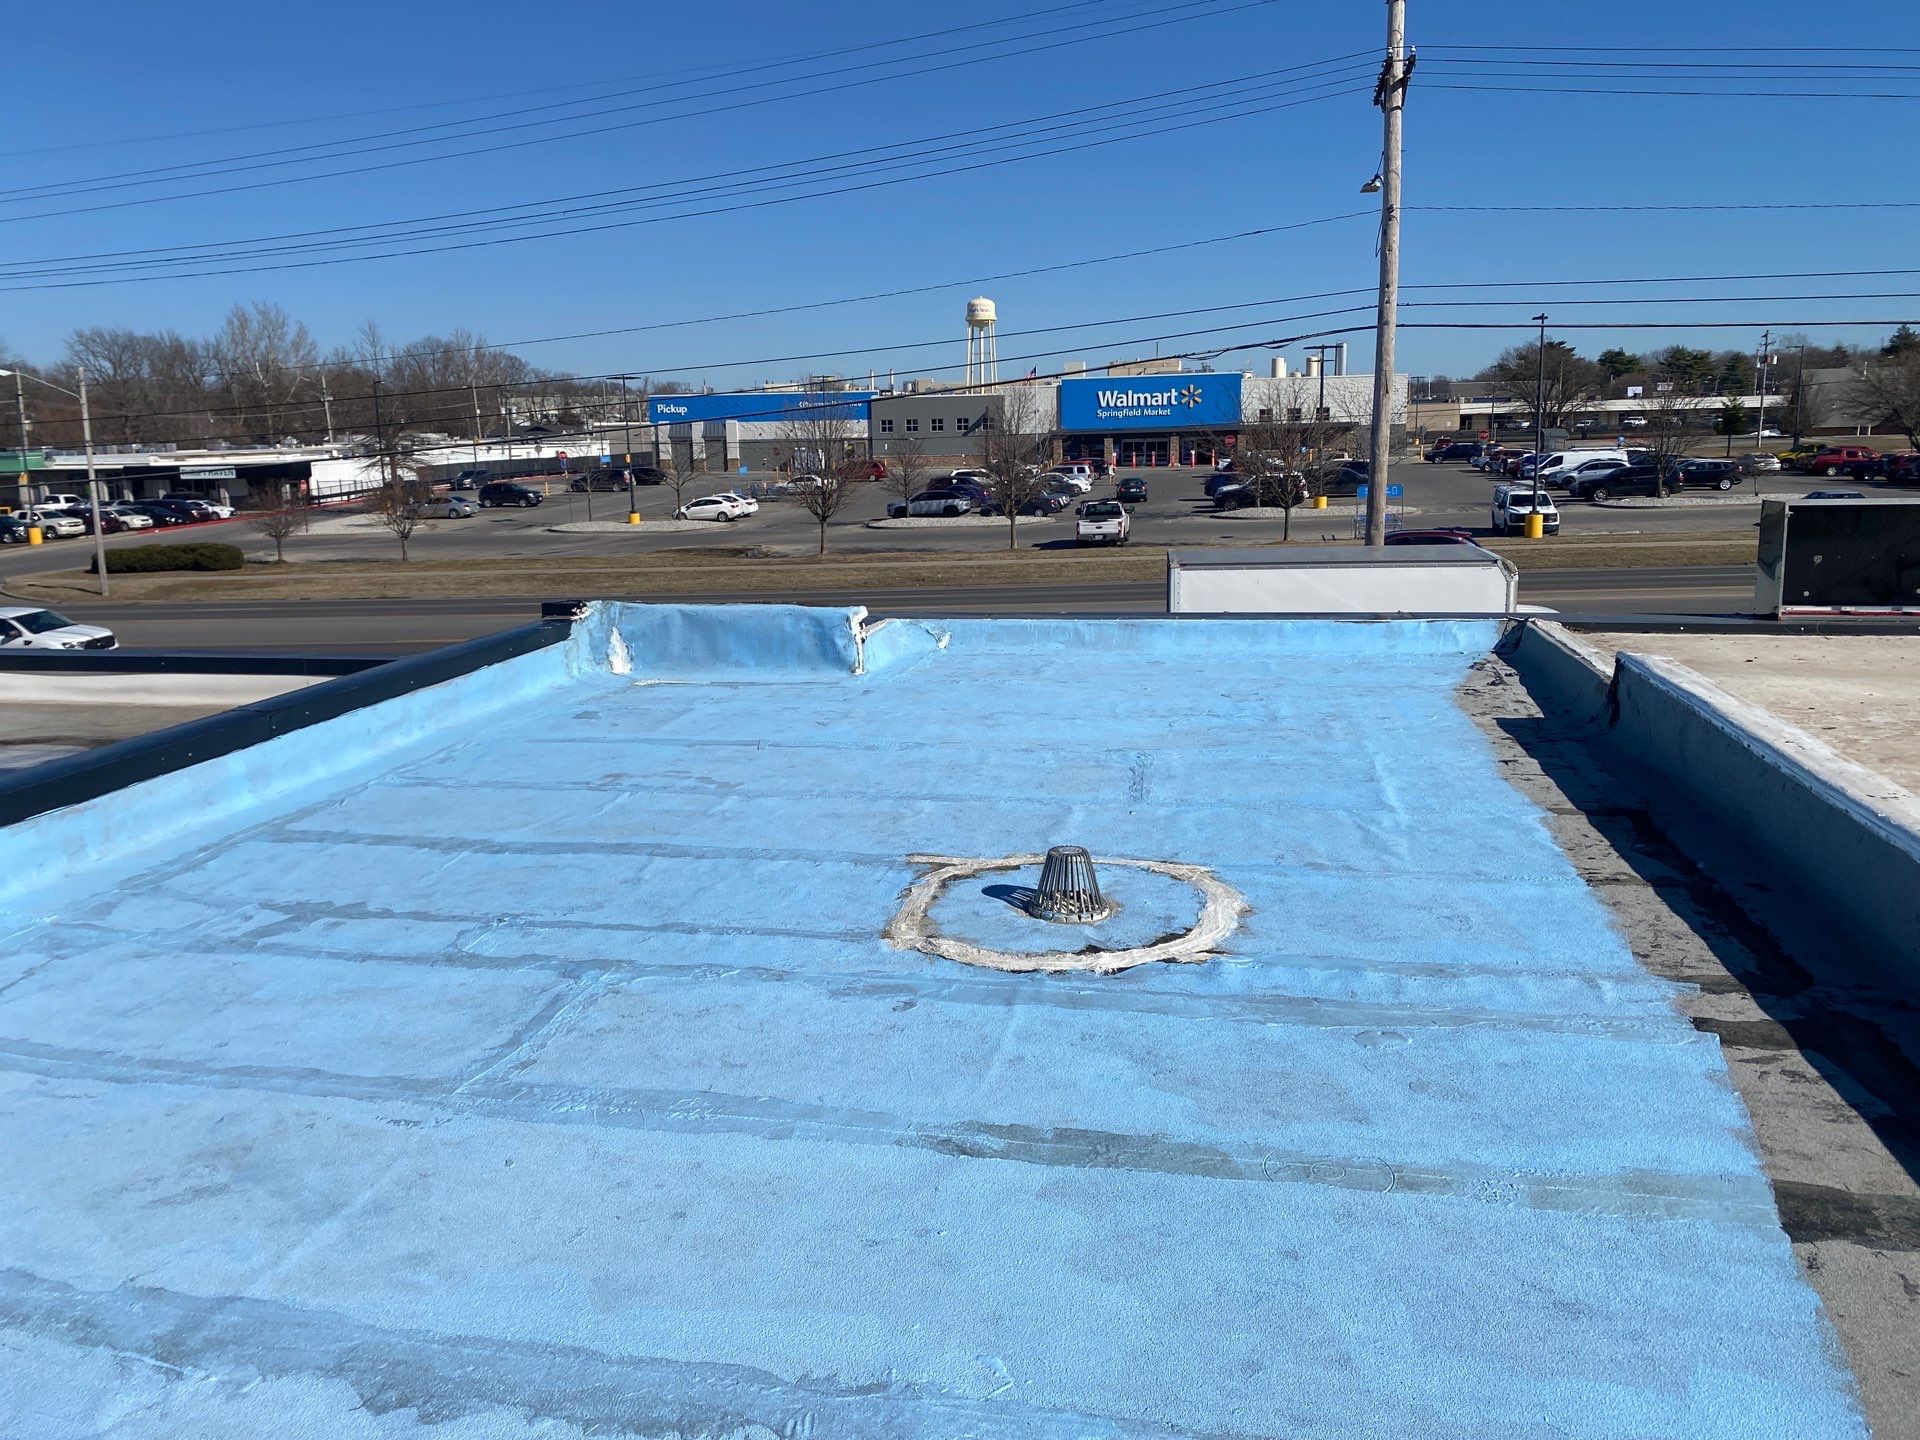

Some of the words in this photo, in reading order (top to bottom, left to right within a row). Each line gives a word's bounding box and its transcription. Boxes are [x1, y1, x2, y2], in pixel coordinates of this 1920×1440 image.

[1097, 388, 1178, 408] Walmart
[657, 404, 687, 416] Pickup
[1097, 408, 1141, 419] Springfield
[1143, 408, 1171, 417] Market
